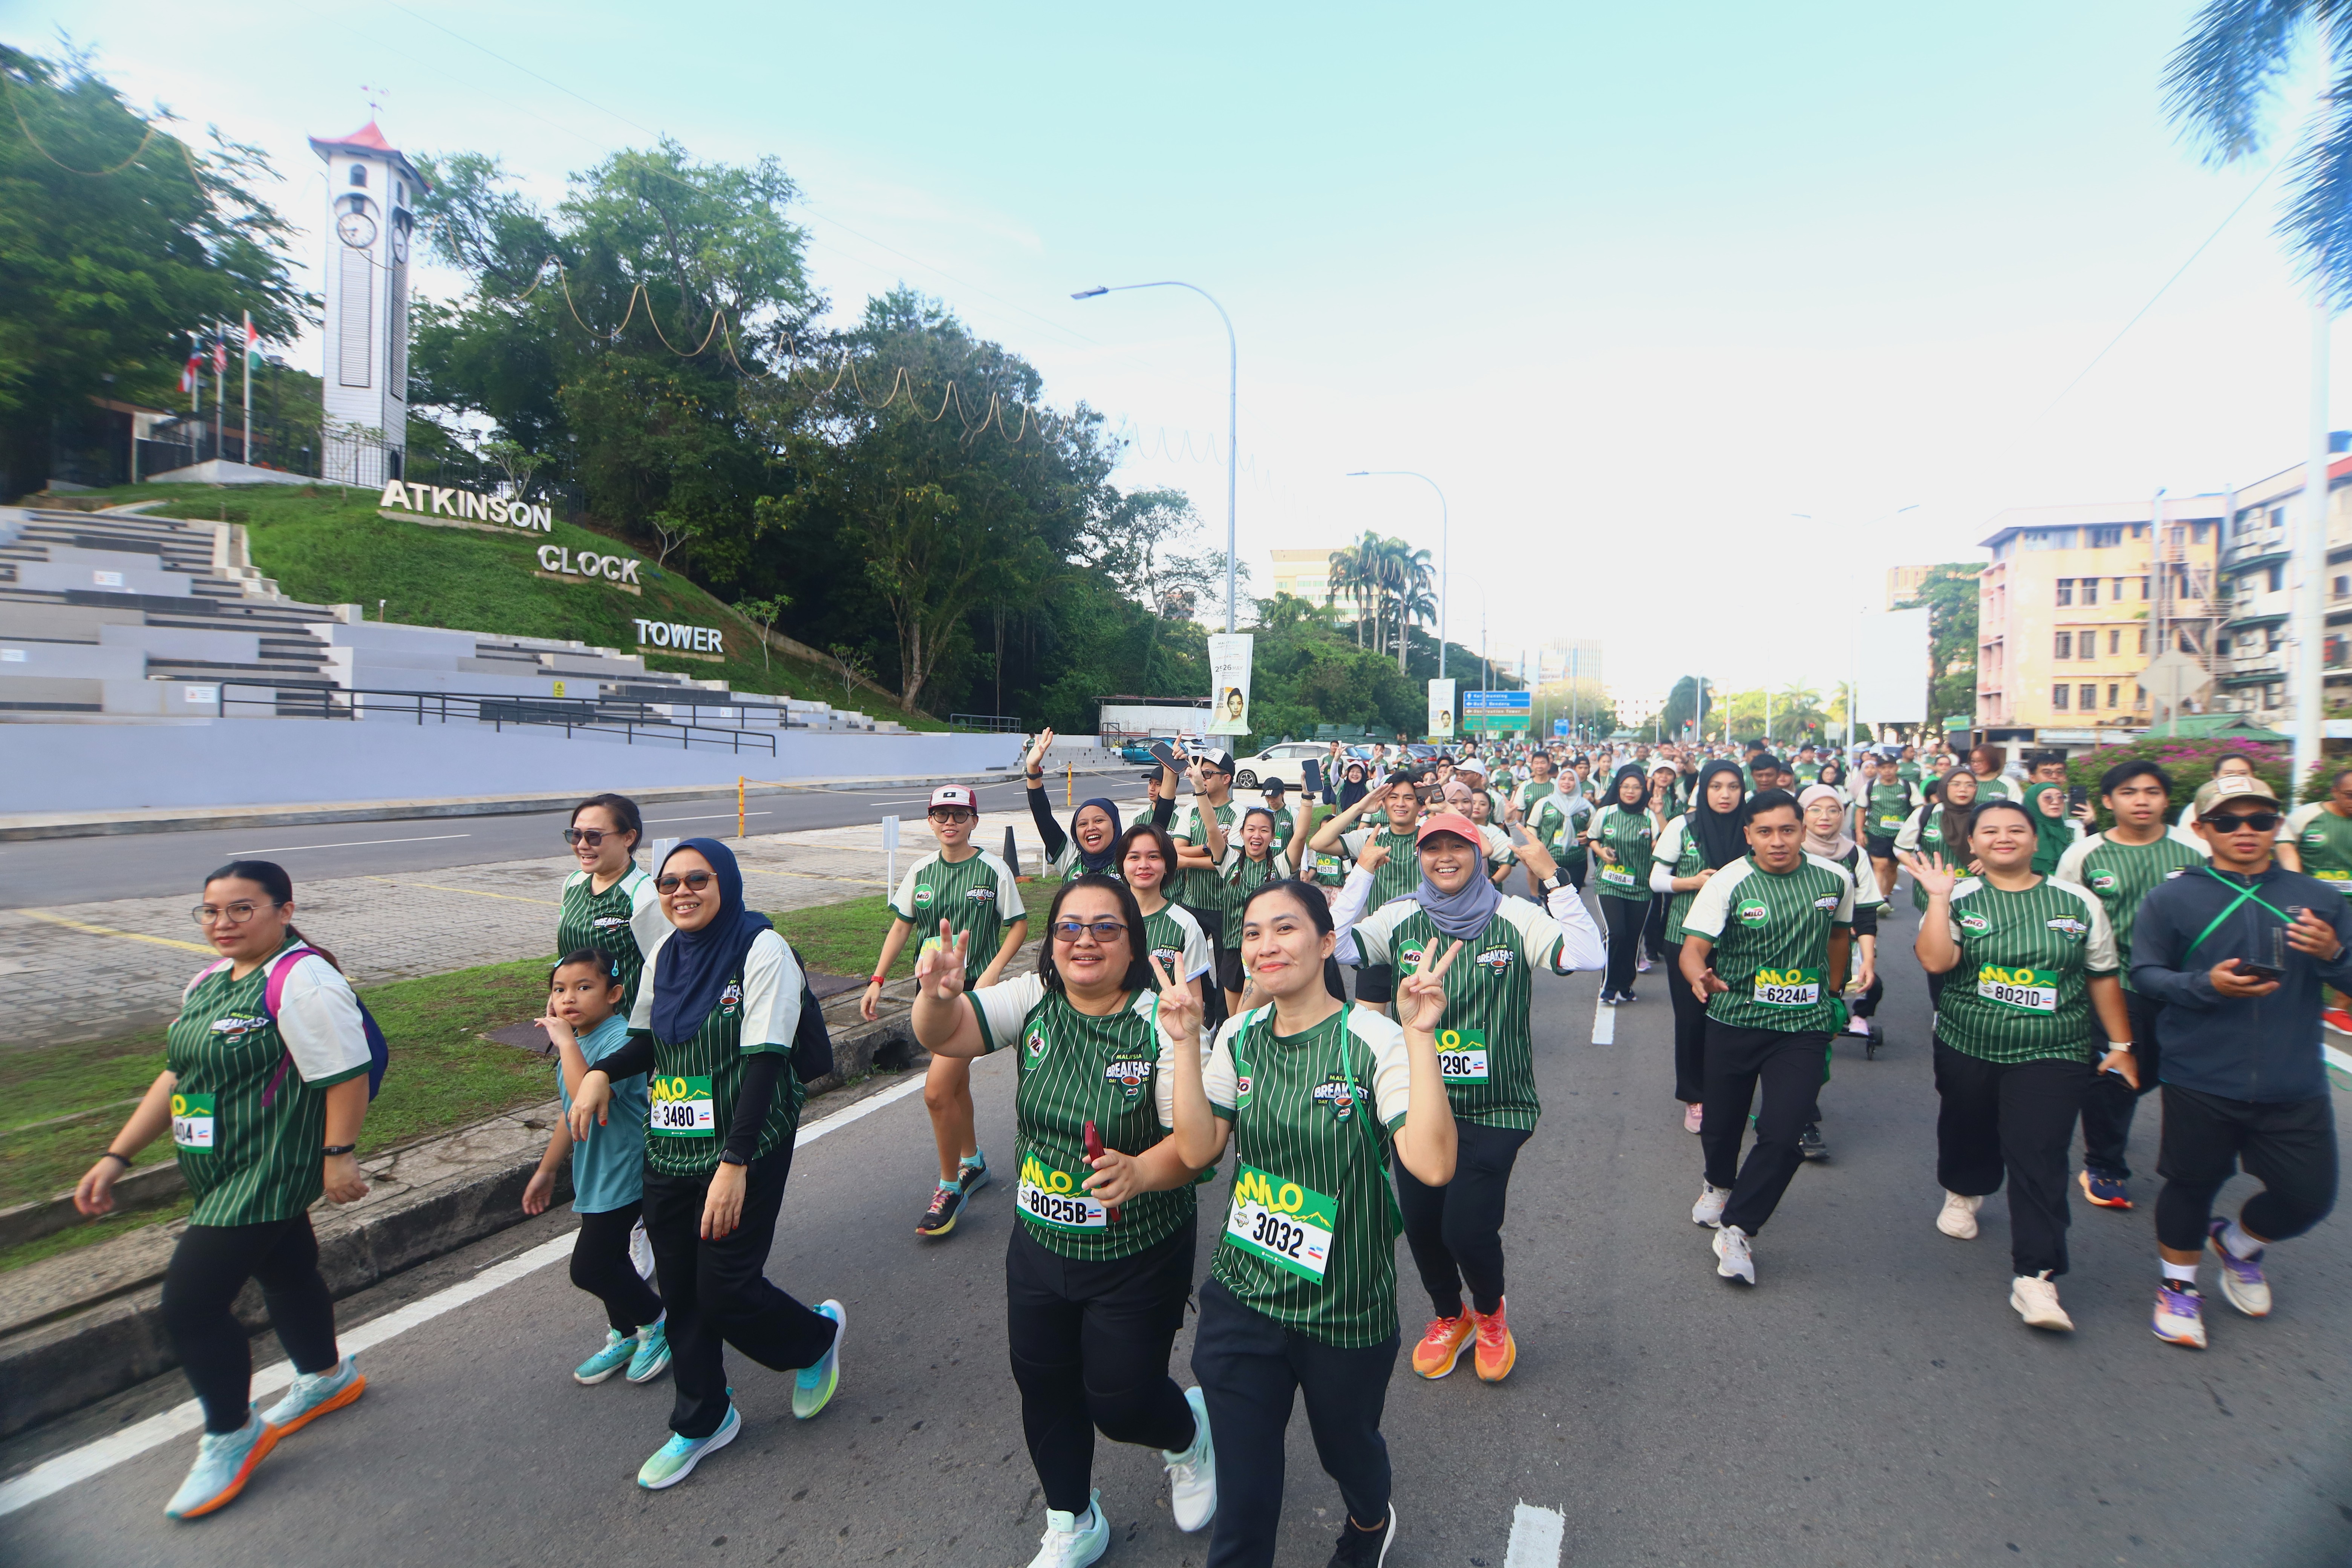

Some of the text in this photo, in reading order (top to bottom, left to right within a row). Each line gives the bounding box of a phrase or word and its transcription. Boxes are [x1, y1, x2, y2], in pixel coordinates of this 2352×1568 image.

[380, 479, 552, 532] ATKINSON
[537, 545, 642, 585] CLOCK
[632, 619, 723, 652] TOWER
[966, 888, 995, 898] BREAKFAST
[1152, 948, 1175, 960] BREAKF
[1476, 949, 1514, 963] BREAKFAS
[1755, 969, 1802, 989] MILO
[1978, 966, 2034, 987] MILO
[1767, 988, 1808, 1003] 6224A
[1995, 986, 2040, 1006] 8021D
[1435, 1029, 1460, 1054] LO
[1106, 1061, 1152, 1078] BREAKFAS
[652, 1077, 687, 1108] MILO
[1314, 1083, 1369, 1099] BREAKST
[663, 1105, 694, 1127] 3480
[1021, 1156, 1073, 1194] MILO
[1235, 1171, 1304, 1213] MILO
[1031, 1190, 1087, 1223] 8025B
[1253, 1212, 1303, 1259] 3032
